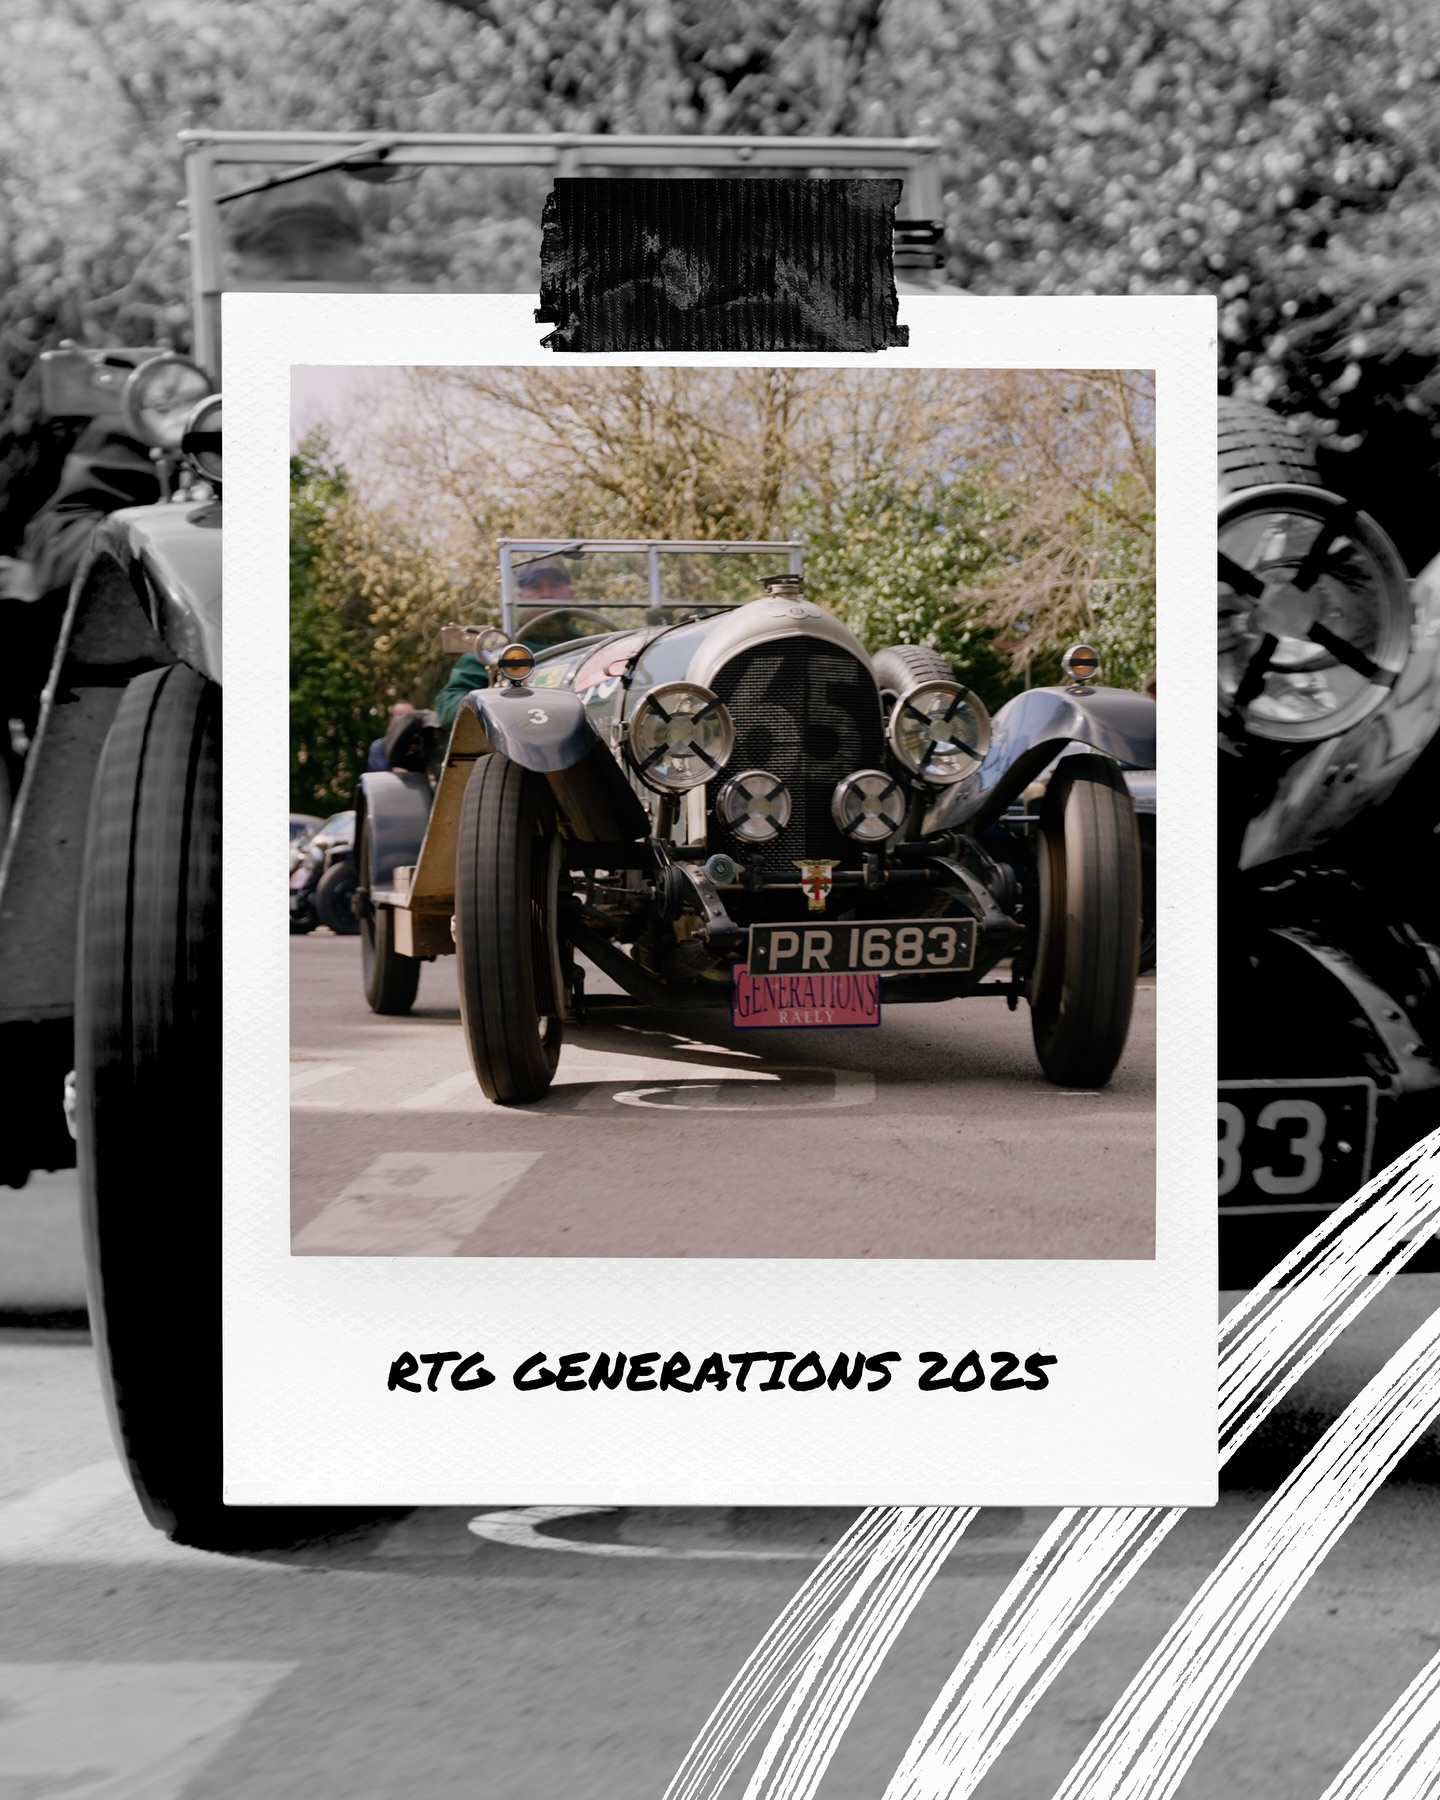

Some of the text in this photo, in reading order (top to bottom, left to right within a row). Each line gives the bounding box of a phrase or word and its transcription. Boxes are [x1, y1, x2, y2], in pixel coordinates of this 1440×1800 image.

[527, 708, 549, 724] 3
[768, 926, 958, 971] PR 1683
[778, 1010, 835, 1025] RALLY
